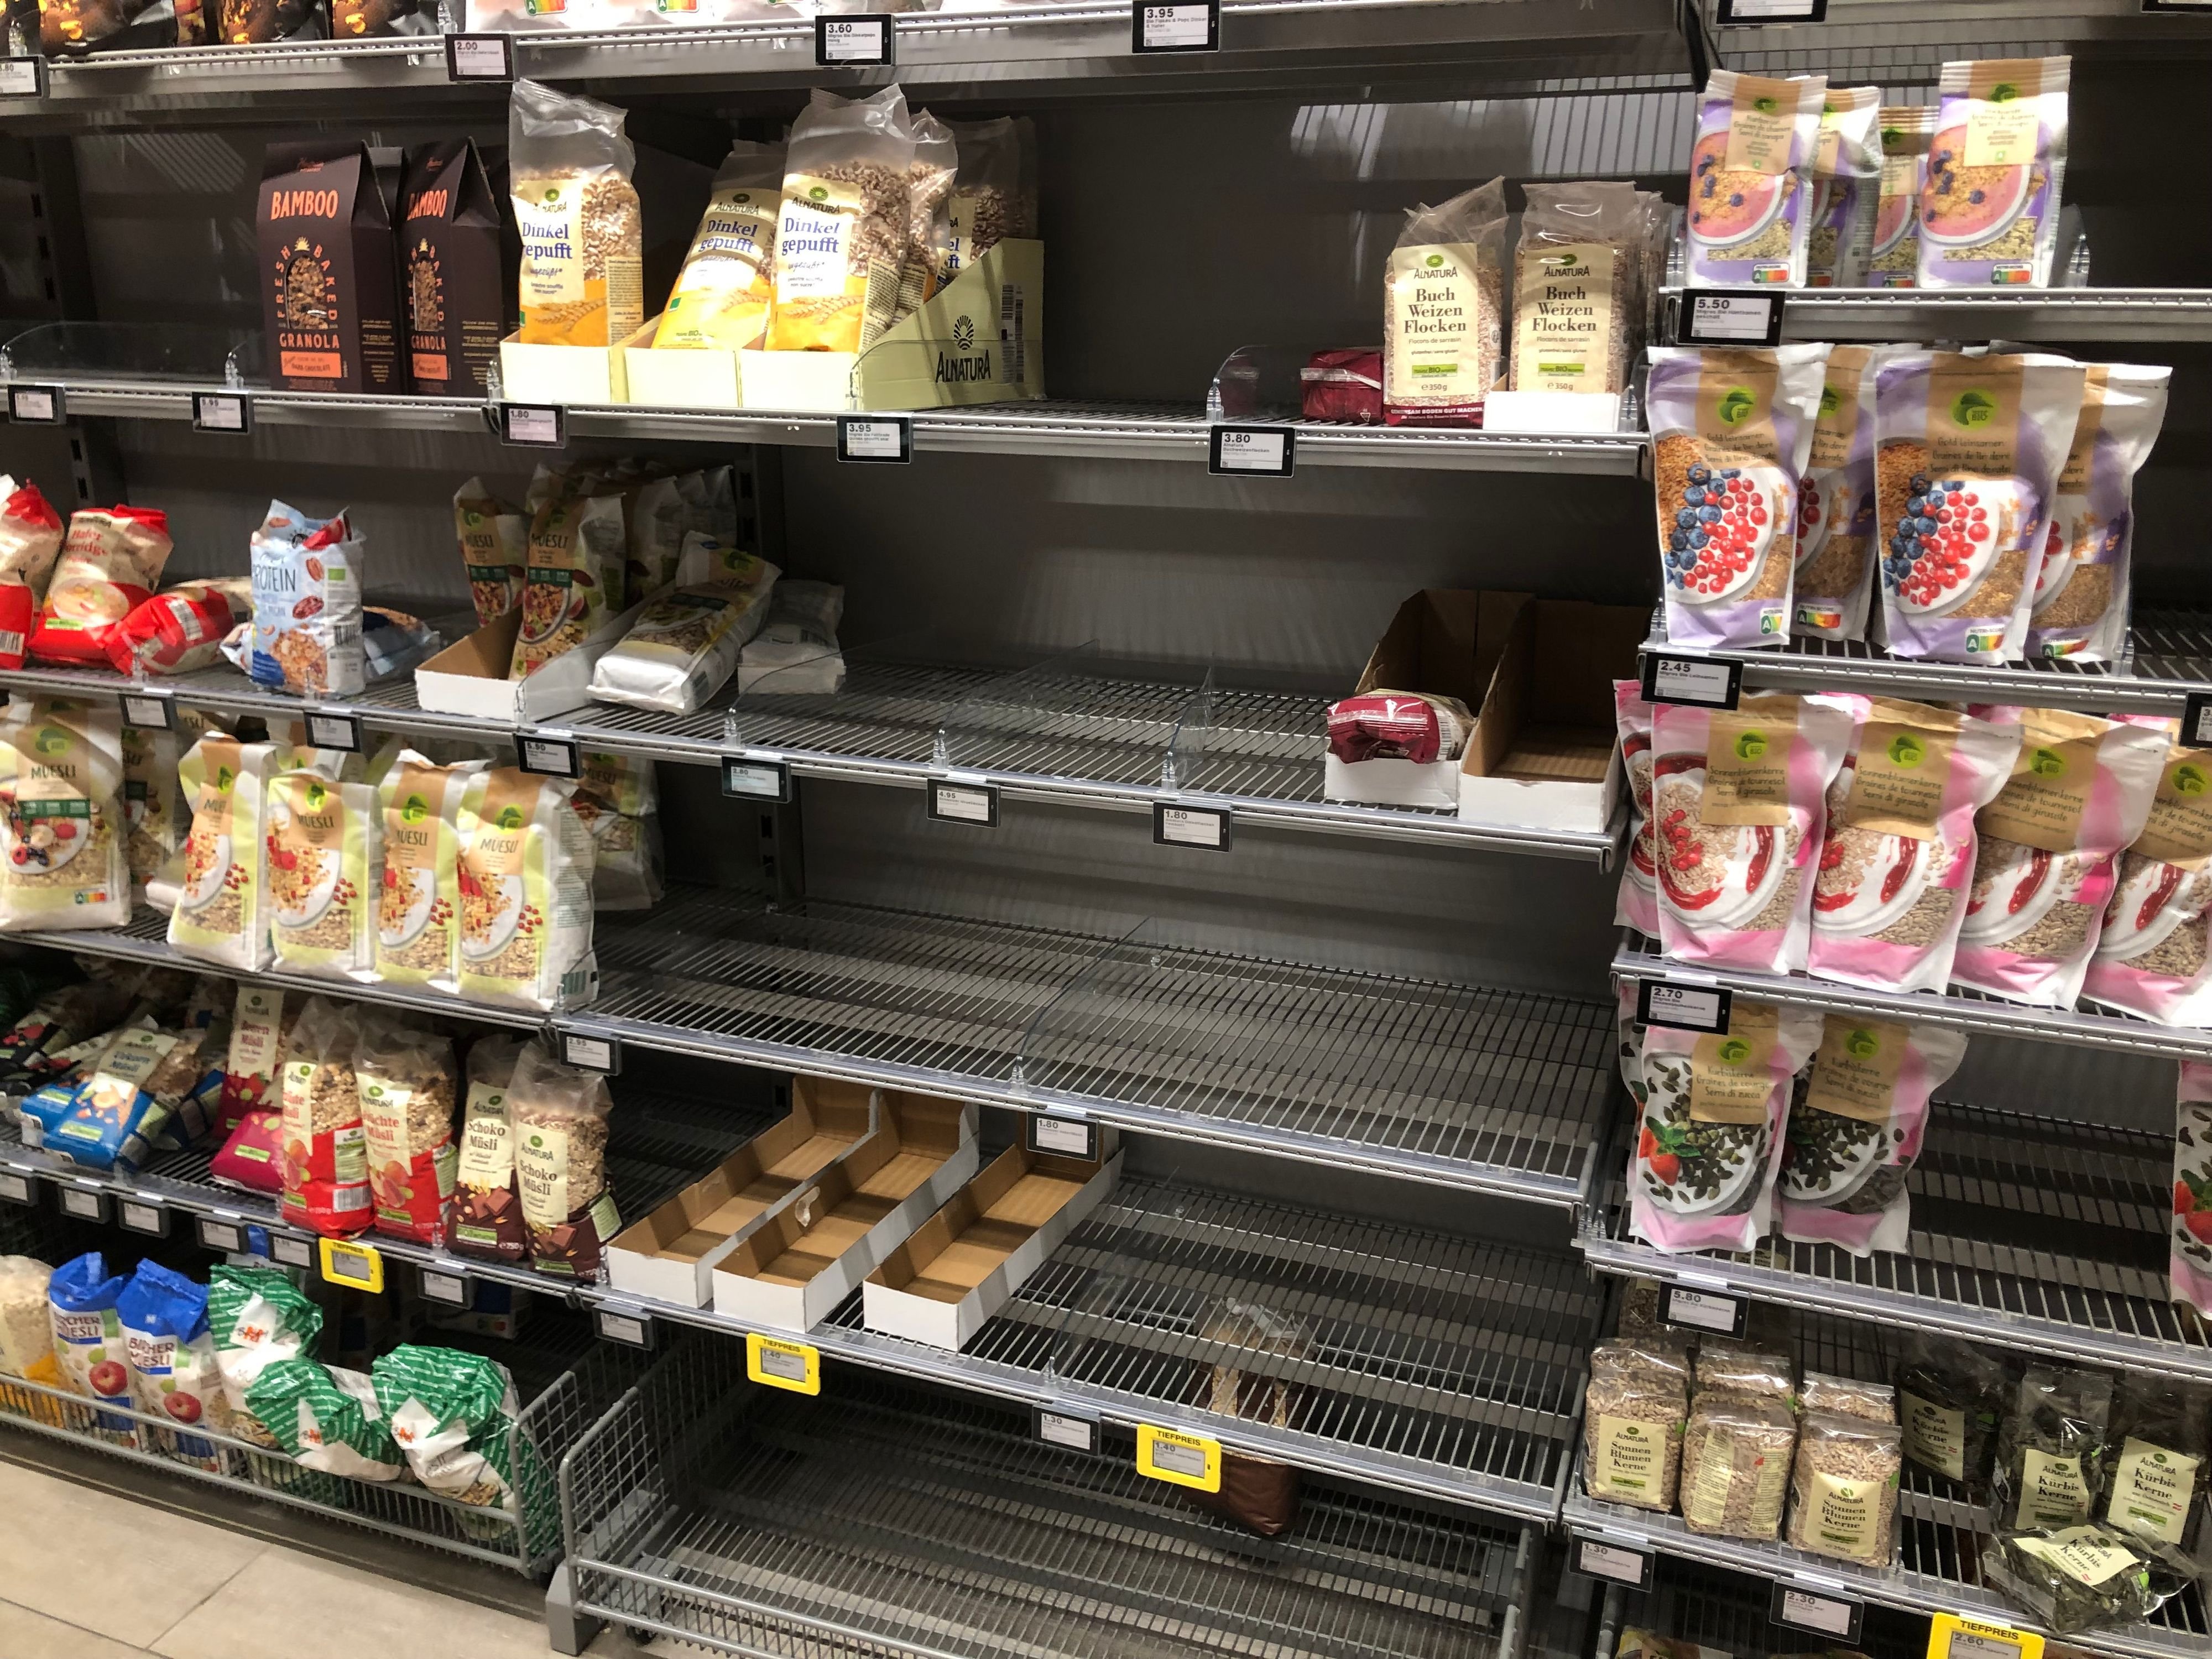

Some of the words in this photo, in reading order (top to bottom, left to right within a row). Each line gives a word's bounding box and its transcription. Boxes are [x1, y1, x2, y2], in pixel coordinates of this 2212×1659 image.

[1147, 8, 1173, 18] 3.95
[828, 24, 852, 33] 3.60
[457, 42, 478, 50] 2.00
[270, 189, 339, 221] BAMBOO
[714, 201, 760, 216] ALNATURA
[791, 196, 841, 215] ALNATURA
[522, 222, 570, 239] Dinkel
[706, 219, 758, 238] Dinkel
[785, 217, 840, 234] Dinkel
[523, 242, 573, 260] epufft
[700, 236, 754, 253] gepufft
[781, 237, 839, 256] gepufft
[1413, 267, 1458, 279] ALNATURA
[1544, 265, 1590, 276] ALNATURA
[1416, 288, 1455, 303] Buch
[1546, 286, 1586, 300] Buch
[1408, 304, 1463, 318] Weizen
[1538, 302, 1593, 316] Weizen
[1698, 299, 1730, 309] 5.50
[1404, 319, 1467, 333] Flocken
[1532, 317, 1597, 332] Flocken
[279, 332, 340, 349] GRANOLA
[411, 335, 447, 351] GRANOLA
[936, 349, 991, 383] ALNATURA
[510, 410, 529, 419] 1.80
[849, 424, 872, 432] 3.95
[1224, 434, 1250, 443] 3.80
[1661, 661, 1691, 672] 2.45
[1710, 765, 1785, 776] Sonnenblumenkerne
[1858, 765, 1942, 789] Sonnenblumenkerne
[1708, 775, 1737, 786] Graines
[1747, 776, 1786, 785] tournesol
[1856, 775, 1886, 790] Graines
[1888, 782, 1898, 792] de
[1900, 784, 1941, 800] tournesol
[939, 791, 956, 799] 4.95
[1743, 786, 1776, 798] girasole
[1863, 787, 1882, 800] Semi
[1895, 796, 1928, 809] girasole
[2027, 793, 2037, 803] de
[2039, 797, 2082, 814] tournesol
[1166, 810, 1188, 820] 1.80
[2033, 807, 2068, 822] girasole
[1654, 988, 1683, 999] 2.70
[1728, 1078, 1739, 1087] de
[1705, 1086, 1725, 1097] Semi
[1727, 1089, 1736, 1097] di
[467, 1120, 506, 1137] Schoko
[1039, 1119, 1059, 1129] 1.80
[469, 1135, 498, 1151] Müsli
[521, 1142, 554, 1161] ALNATURA
[520, 1159, 558, 1182] Schoko
[1673, 1291, 1702, 1303] 5.80
[763, 1338, 801, 1353] TIEFPREIS
[1043, 1415, 1063, 1425] 1.30
[1156, 1430, 1201, 1447] TIEFPREIS
[1615, 1432, 1649, 1443] ALNATURA
[1155, 1442, 1176, 1452] 1.40
[1610, 1441, 1651, 1454] Sonnen
[1610, 1448, 1651, 1463] Blumen
[1613, 1458, 1646, 1471] Kerne
[2042, 1465, 2079, 1479] ALNATURA
[2140, 1457, 2177, 1475] ALNATURA
[2038, 1475, 2080, 1491] Kürbis
[2134, 1467, 2177, 1489] Kürbis
[2037, 1486, 2077, 1501] Kerne
[2133, 1479, 2173, 1500] Kerne
[1828, 1491, 1864, 1504] ALNATURA
[1822, 1506, 1866, 1521] Blumen
[1823, 1499, 1866, 1514] Sonnen
[1824, 1516, 1860, 1528] Kerne
[1584, 1543, 1609, 1554] 1.30
[2068, 1538, 2102, 1568] Kürbis
[2082, 1535, 2113, 1559] ALNATURA
[2060, 1545, 2090, 1571] Kerne
[1787, 1592, 1816, 1605] 2.30
[1960, 1620, 2020, 1640] TIEFPREIS
[1954, 1632, 1984, 1646] 2.60
